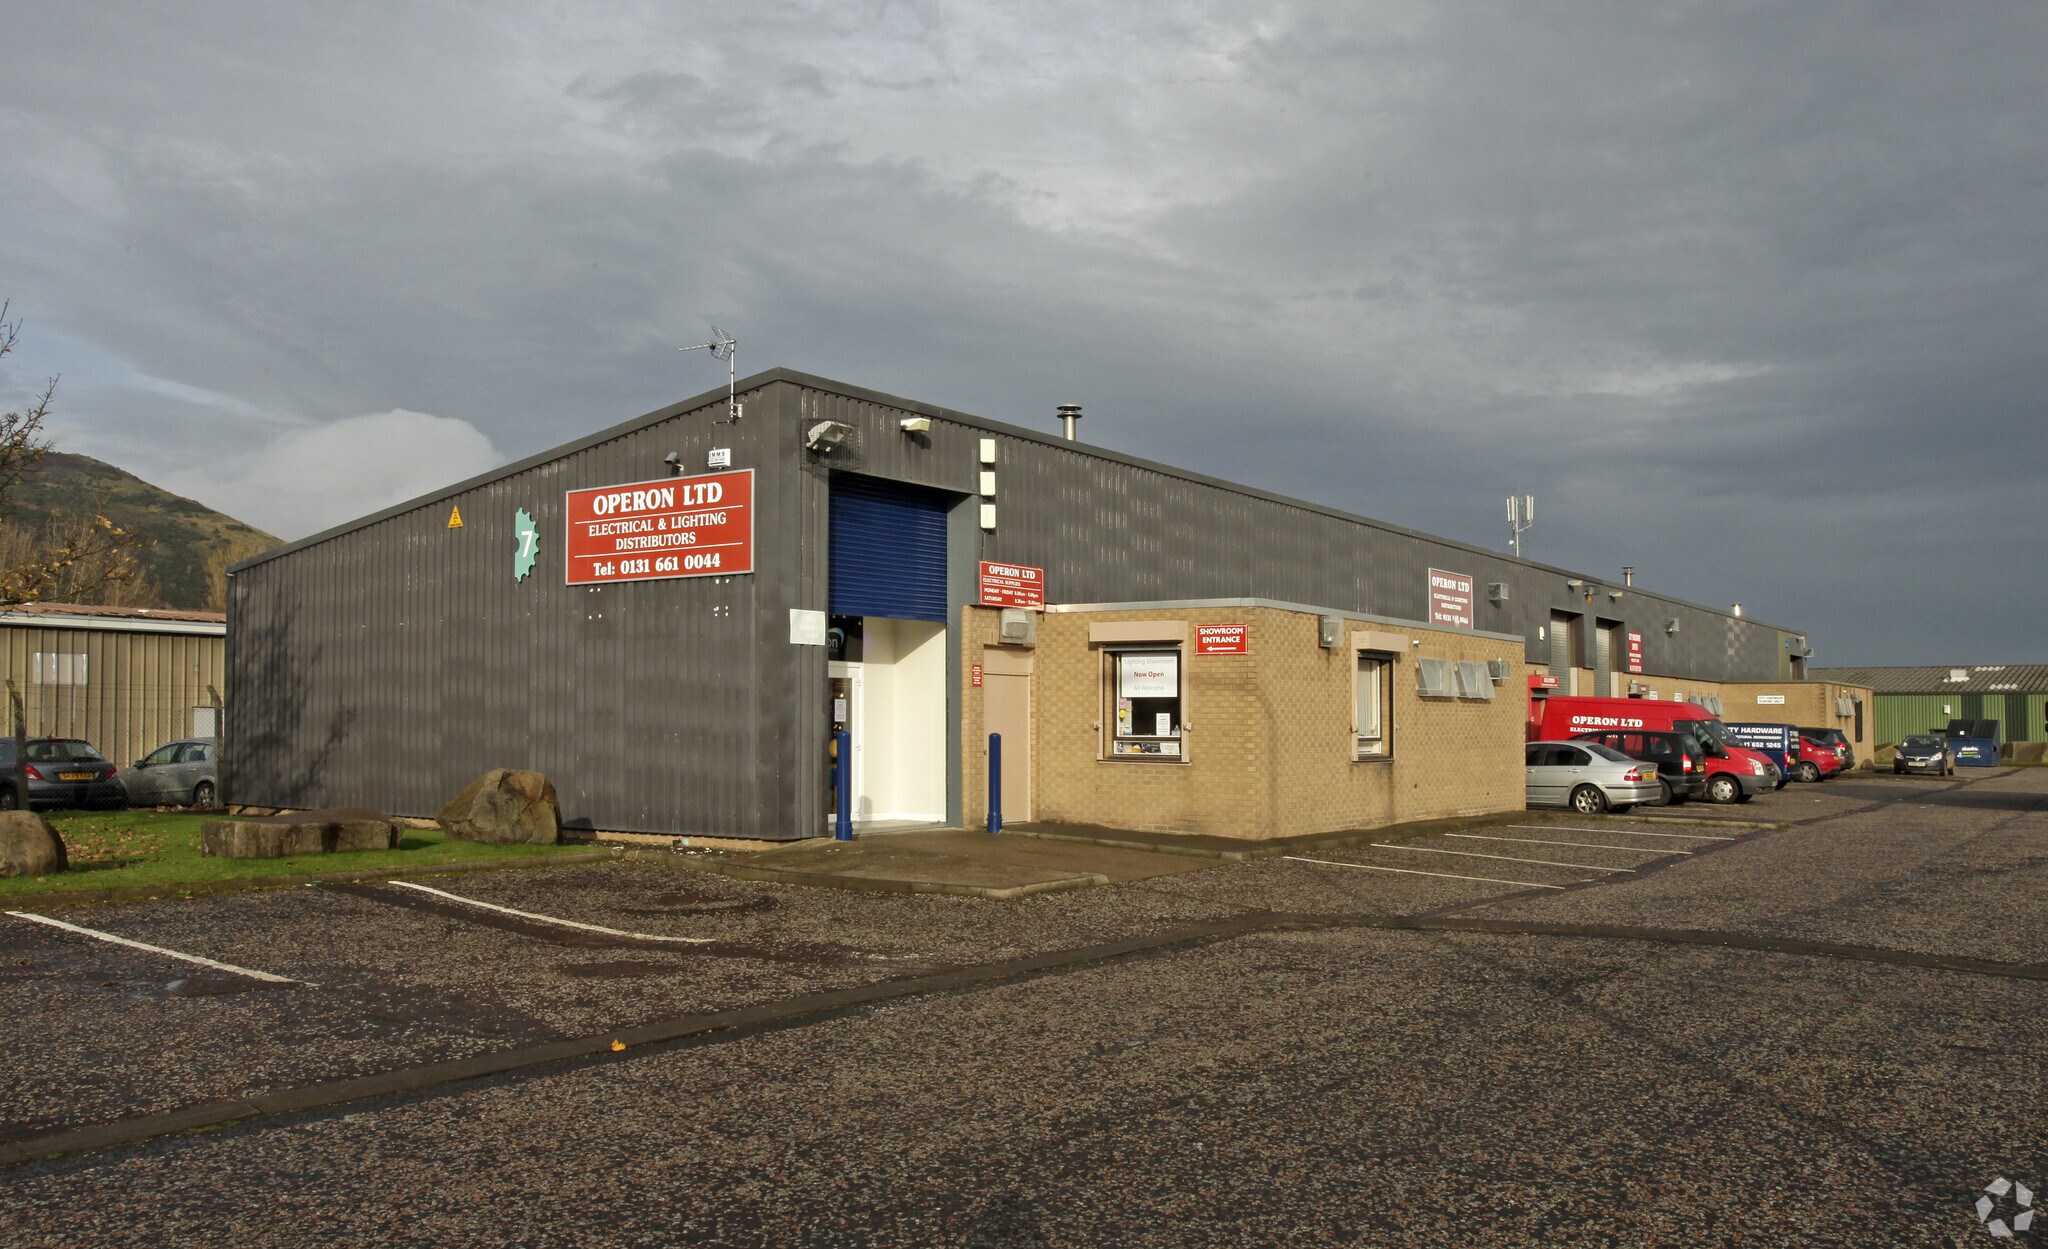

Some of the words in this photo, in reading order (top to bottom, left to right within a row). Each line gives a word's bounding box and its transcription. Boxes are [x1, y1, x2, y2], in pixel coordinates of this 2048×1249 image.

[593, 487, 675, 515] OPERON
[683, 482, 723, 506] LTD
[588, 519, 654, 537] ELECTRICAL
[657, 518, 667, 531] &
[671, 512, 727, 529] LIGHTING
[521, 530, 533, 557] 7
[615, 532, 697, 551] DISTRIBUTORS
[593, 561, 616, 577] Tel:
[620, 559, 650, 574] 0131
[655, 556, 679, 572] 661
[684, 553, 721, 570] 0044
[988, 566, 1020, 578] OPERON
[1022, 570, 1036, 579] LTD
[1432, 576, 1456, 590] OPERON
[1458, 582, 1470, 592] LTD
[1199, 627, 1244, 635] SHOWROOM
[1572, 716, 1619, 726] OPERON
[1620, 718, 1643, 727] LTD
